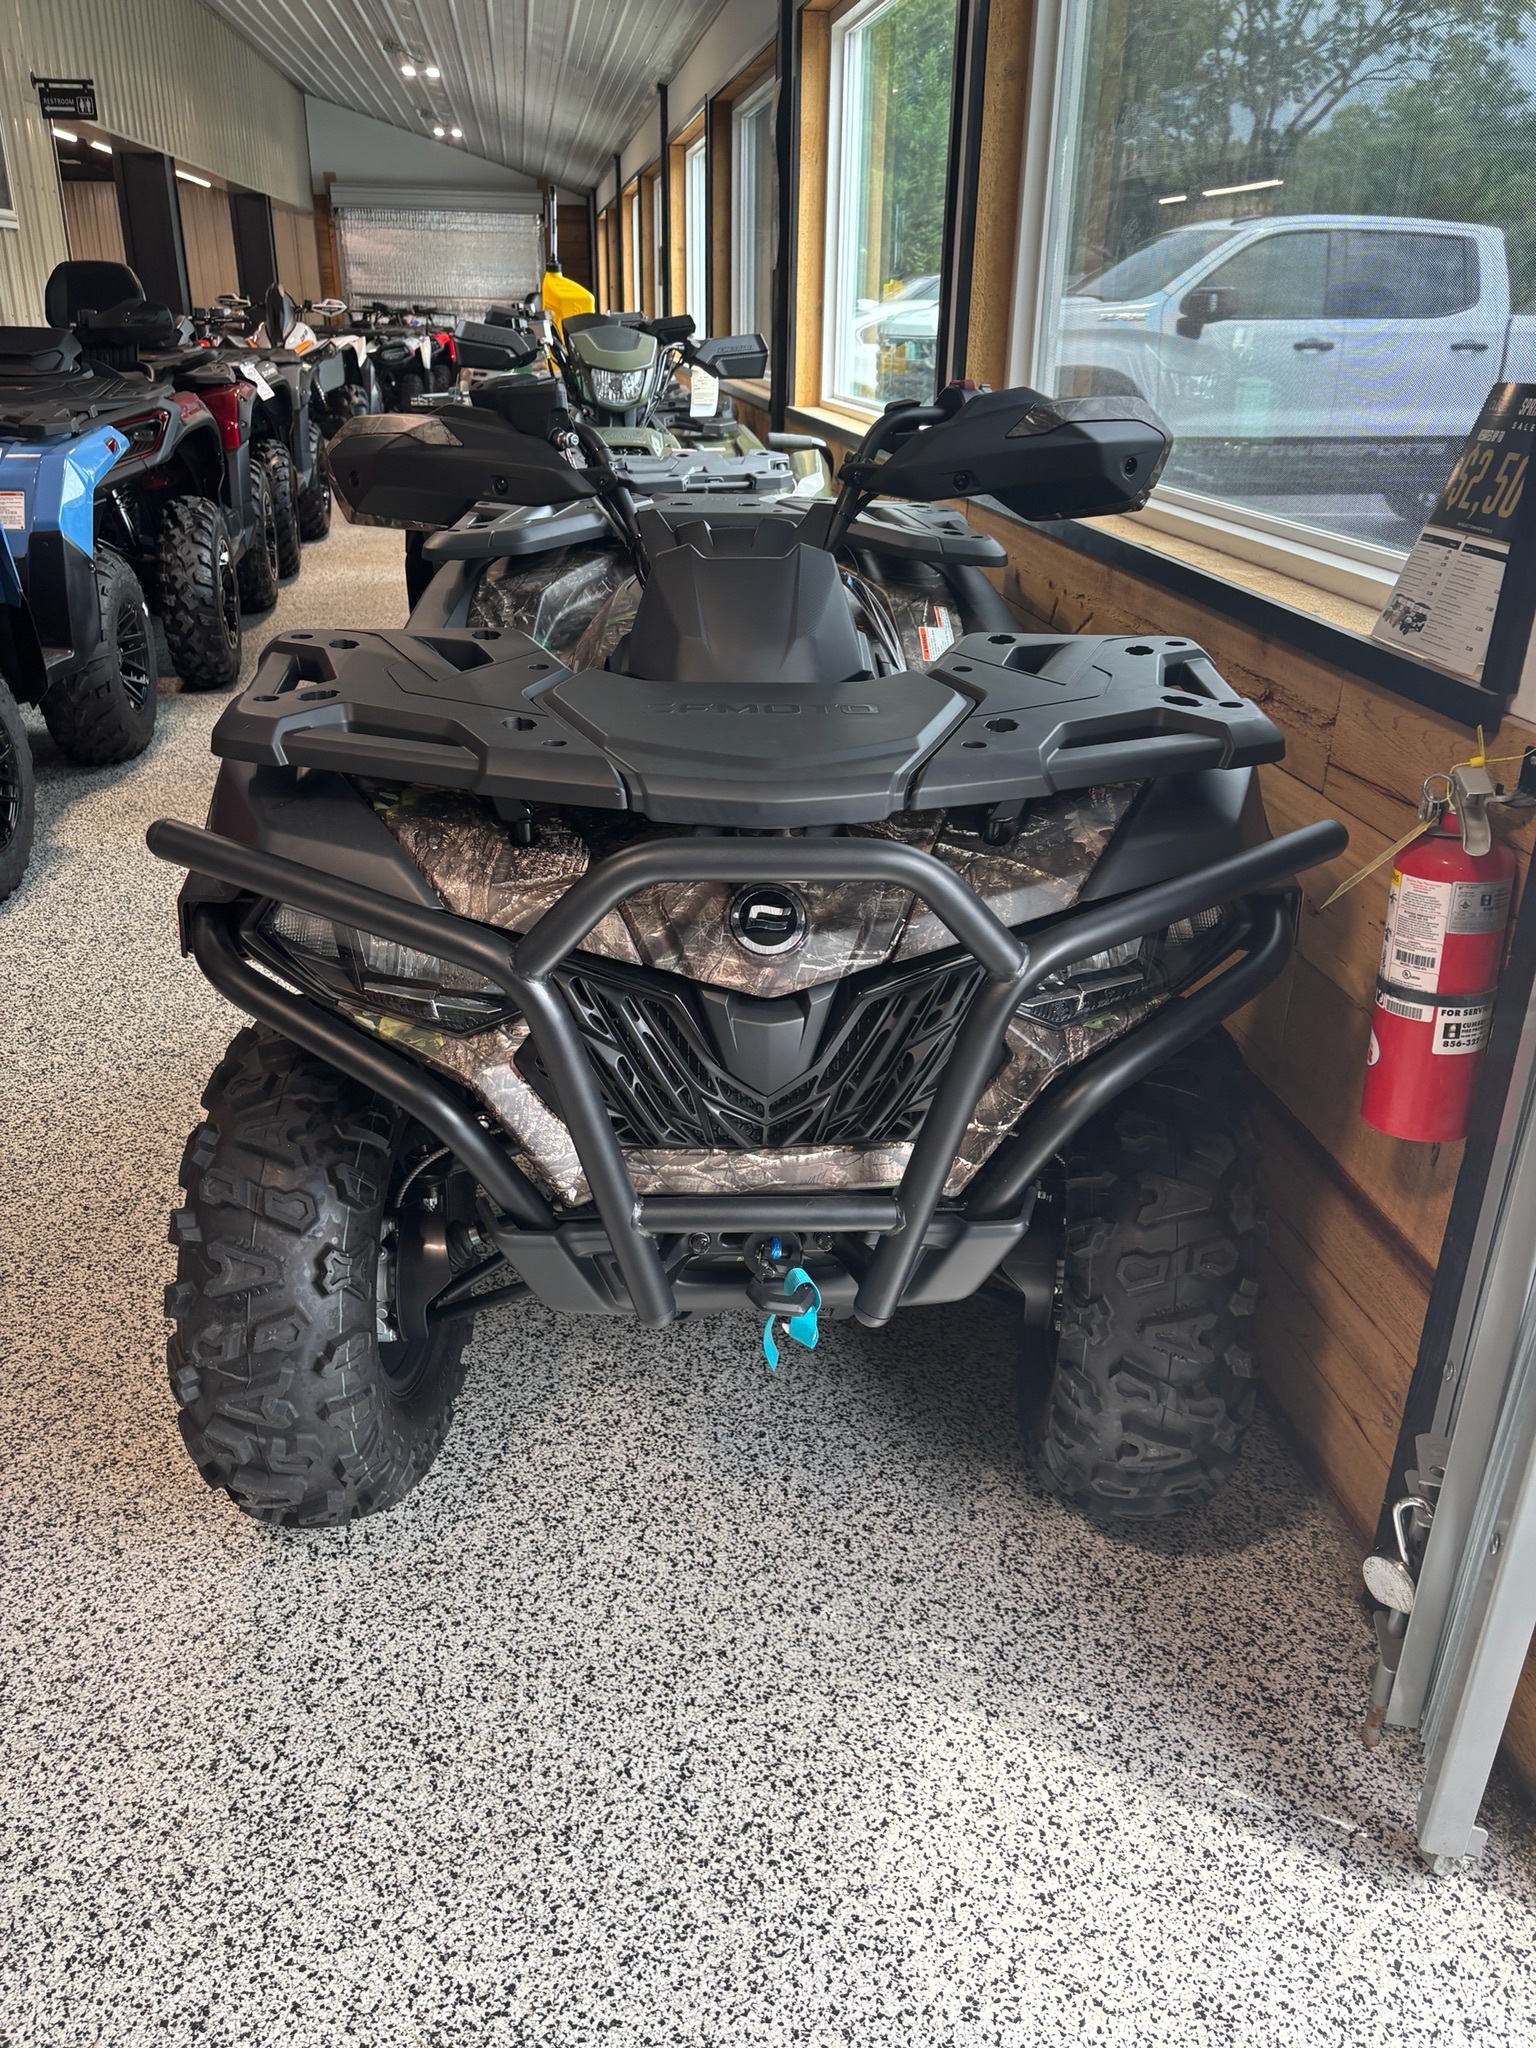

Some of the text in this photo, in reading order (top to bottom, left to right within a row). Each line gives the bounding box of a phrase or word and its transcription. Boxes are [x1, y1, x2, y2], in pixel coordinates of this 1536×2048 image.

[43, 97, 75, 105] RESTROOM
[1511, 421, 1536, 432] SALE
[1441, 1009, 1461, 1017] FOR
